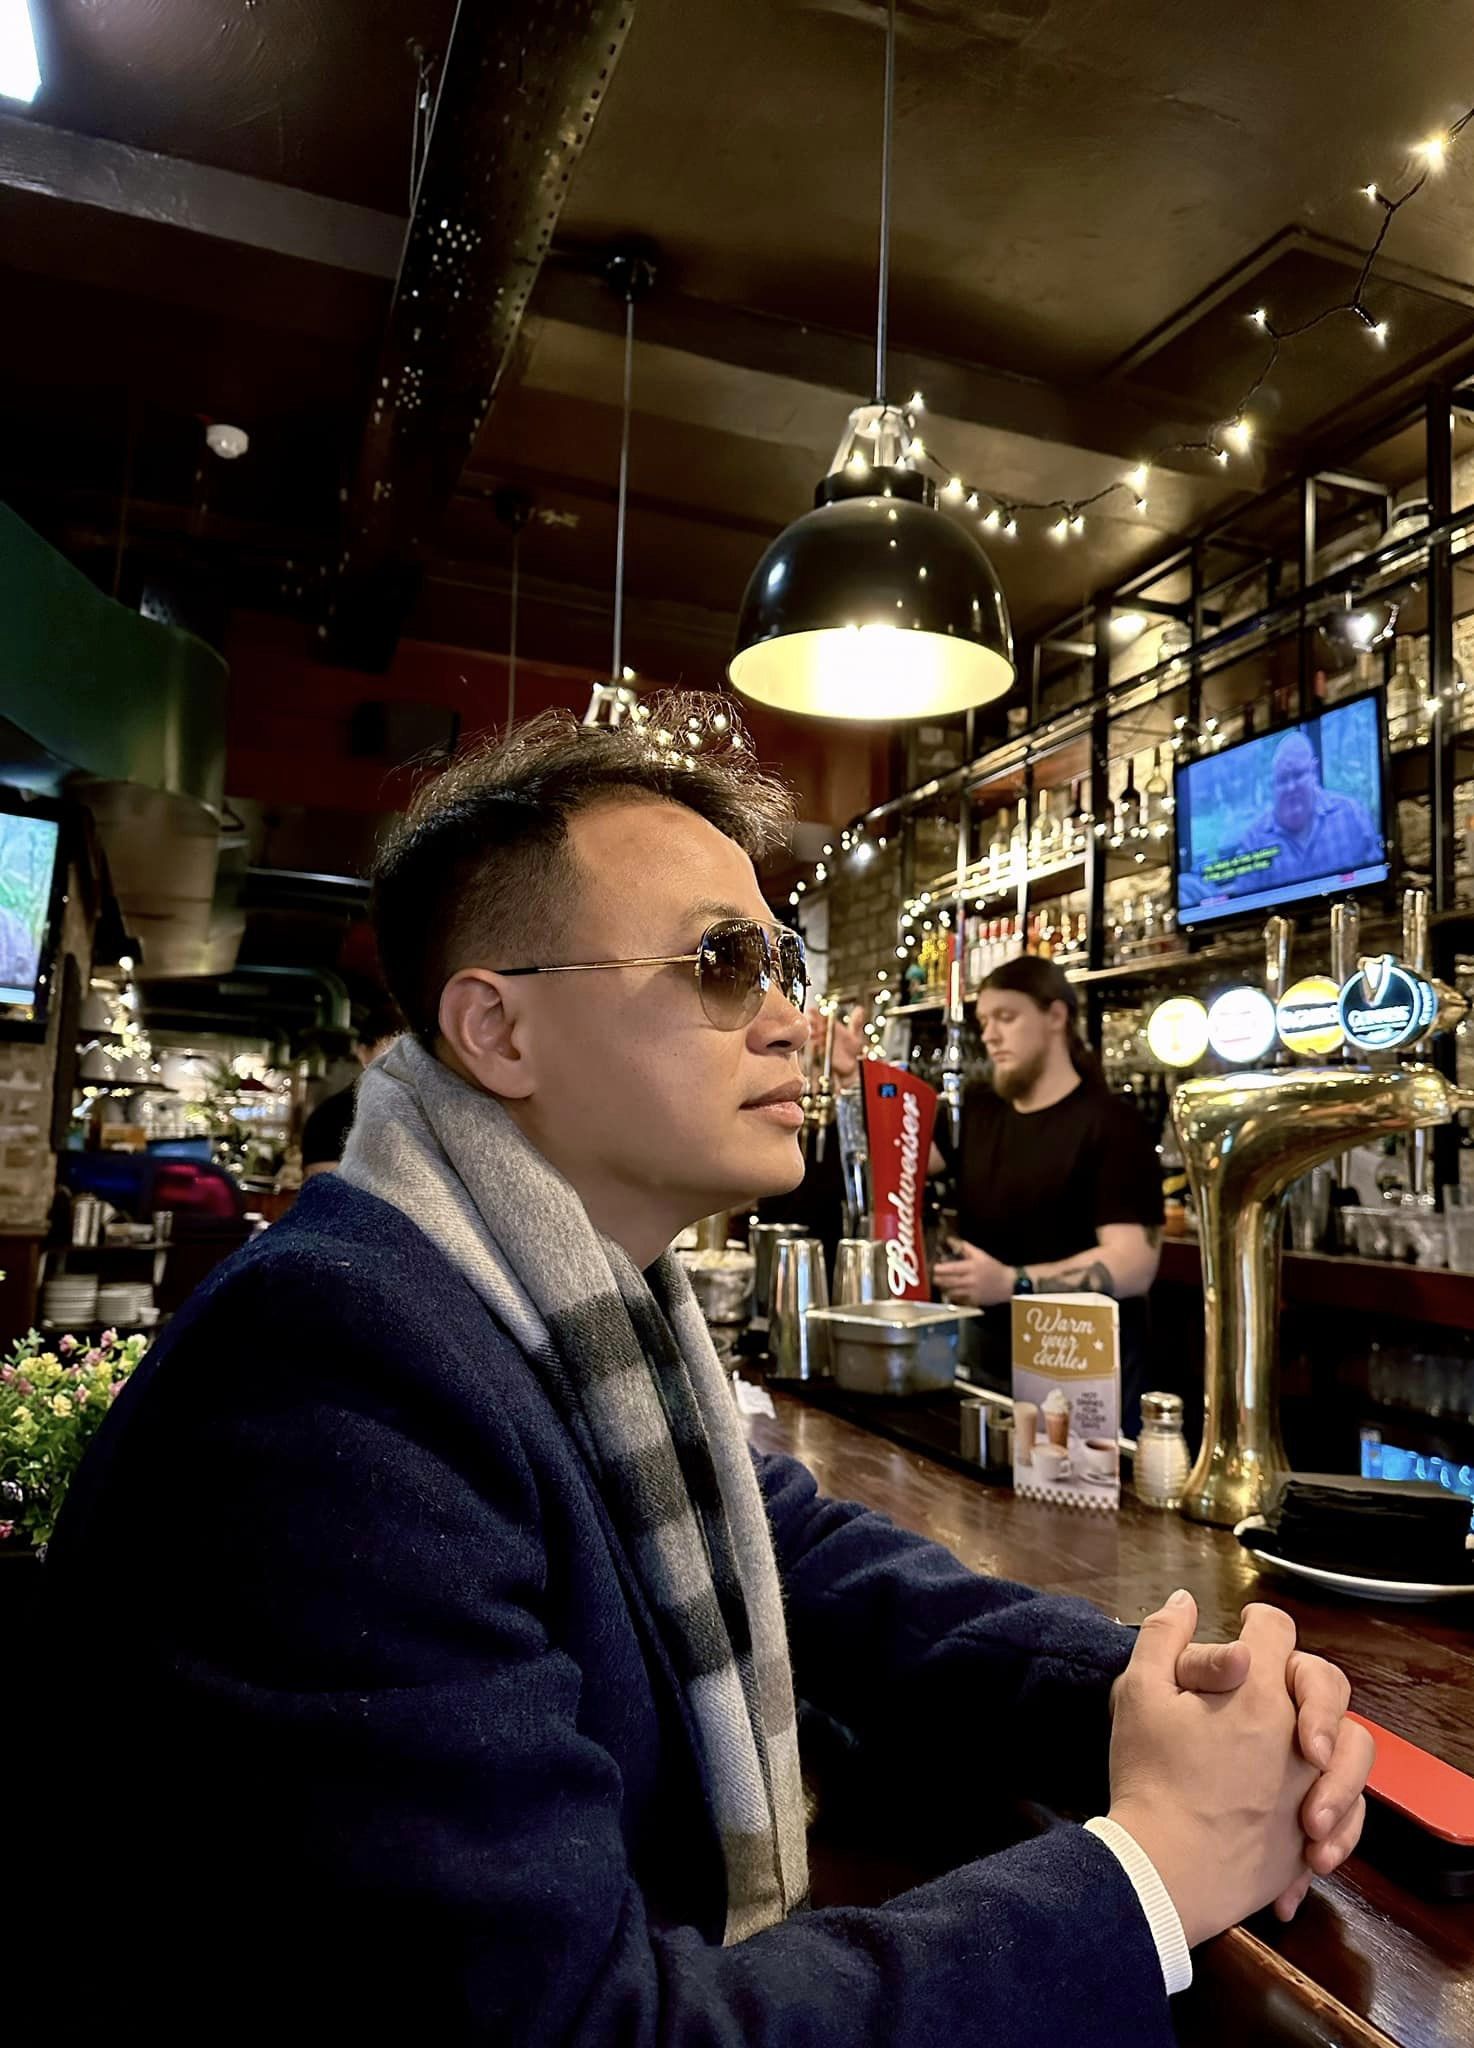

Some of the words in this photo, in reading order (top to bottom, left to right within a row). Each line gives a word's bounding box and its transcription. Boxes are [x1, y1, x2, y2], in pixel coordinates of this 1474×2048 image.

[886, 1092, 920, 1296] Budweiser
[1026, 1307, 1096, 1335] Warm
[1041, 1334, 1079, 1353] your
